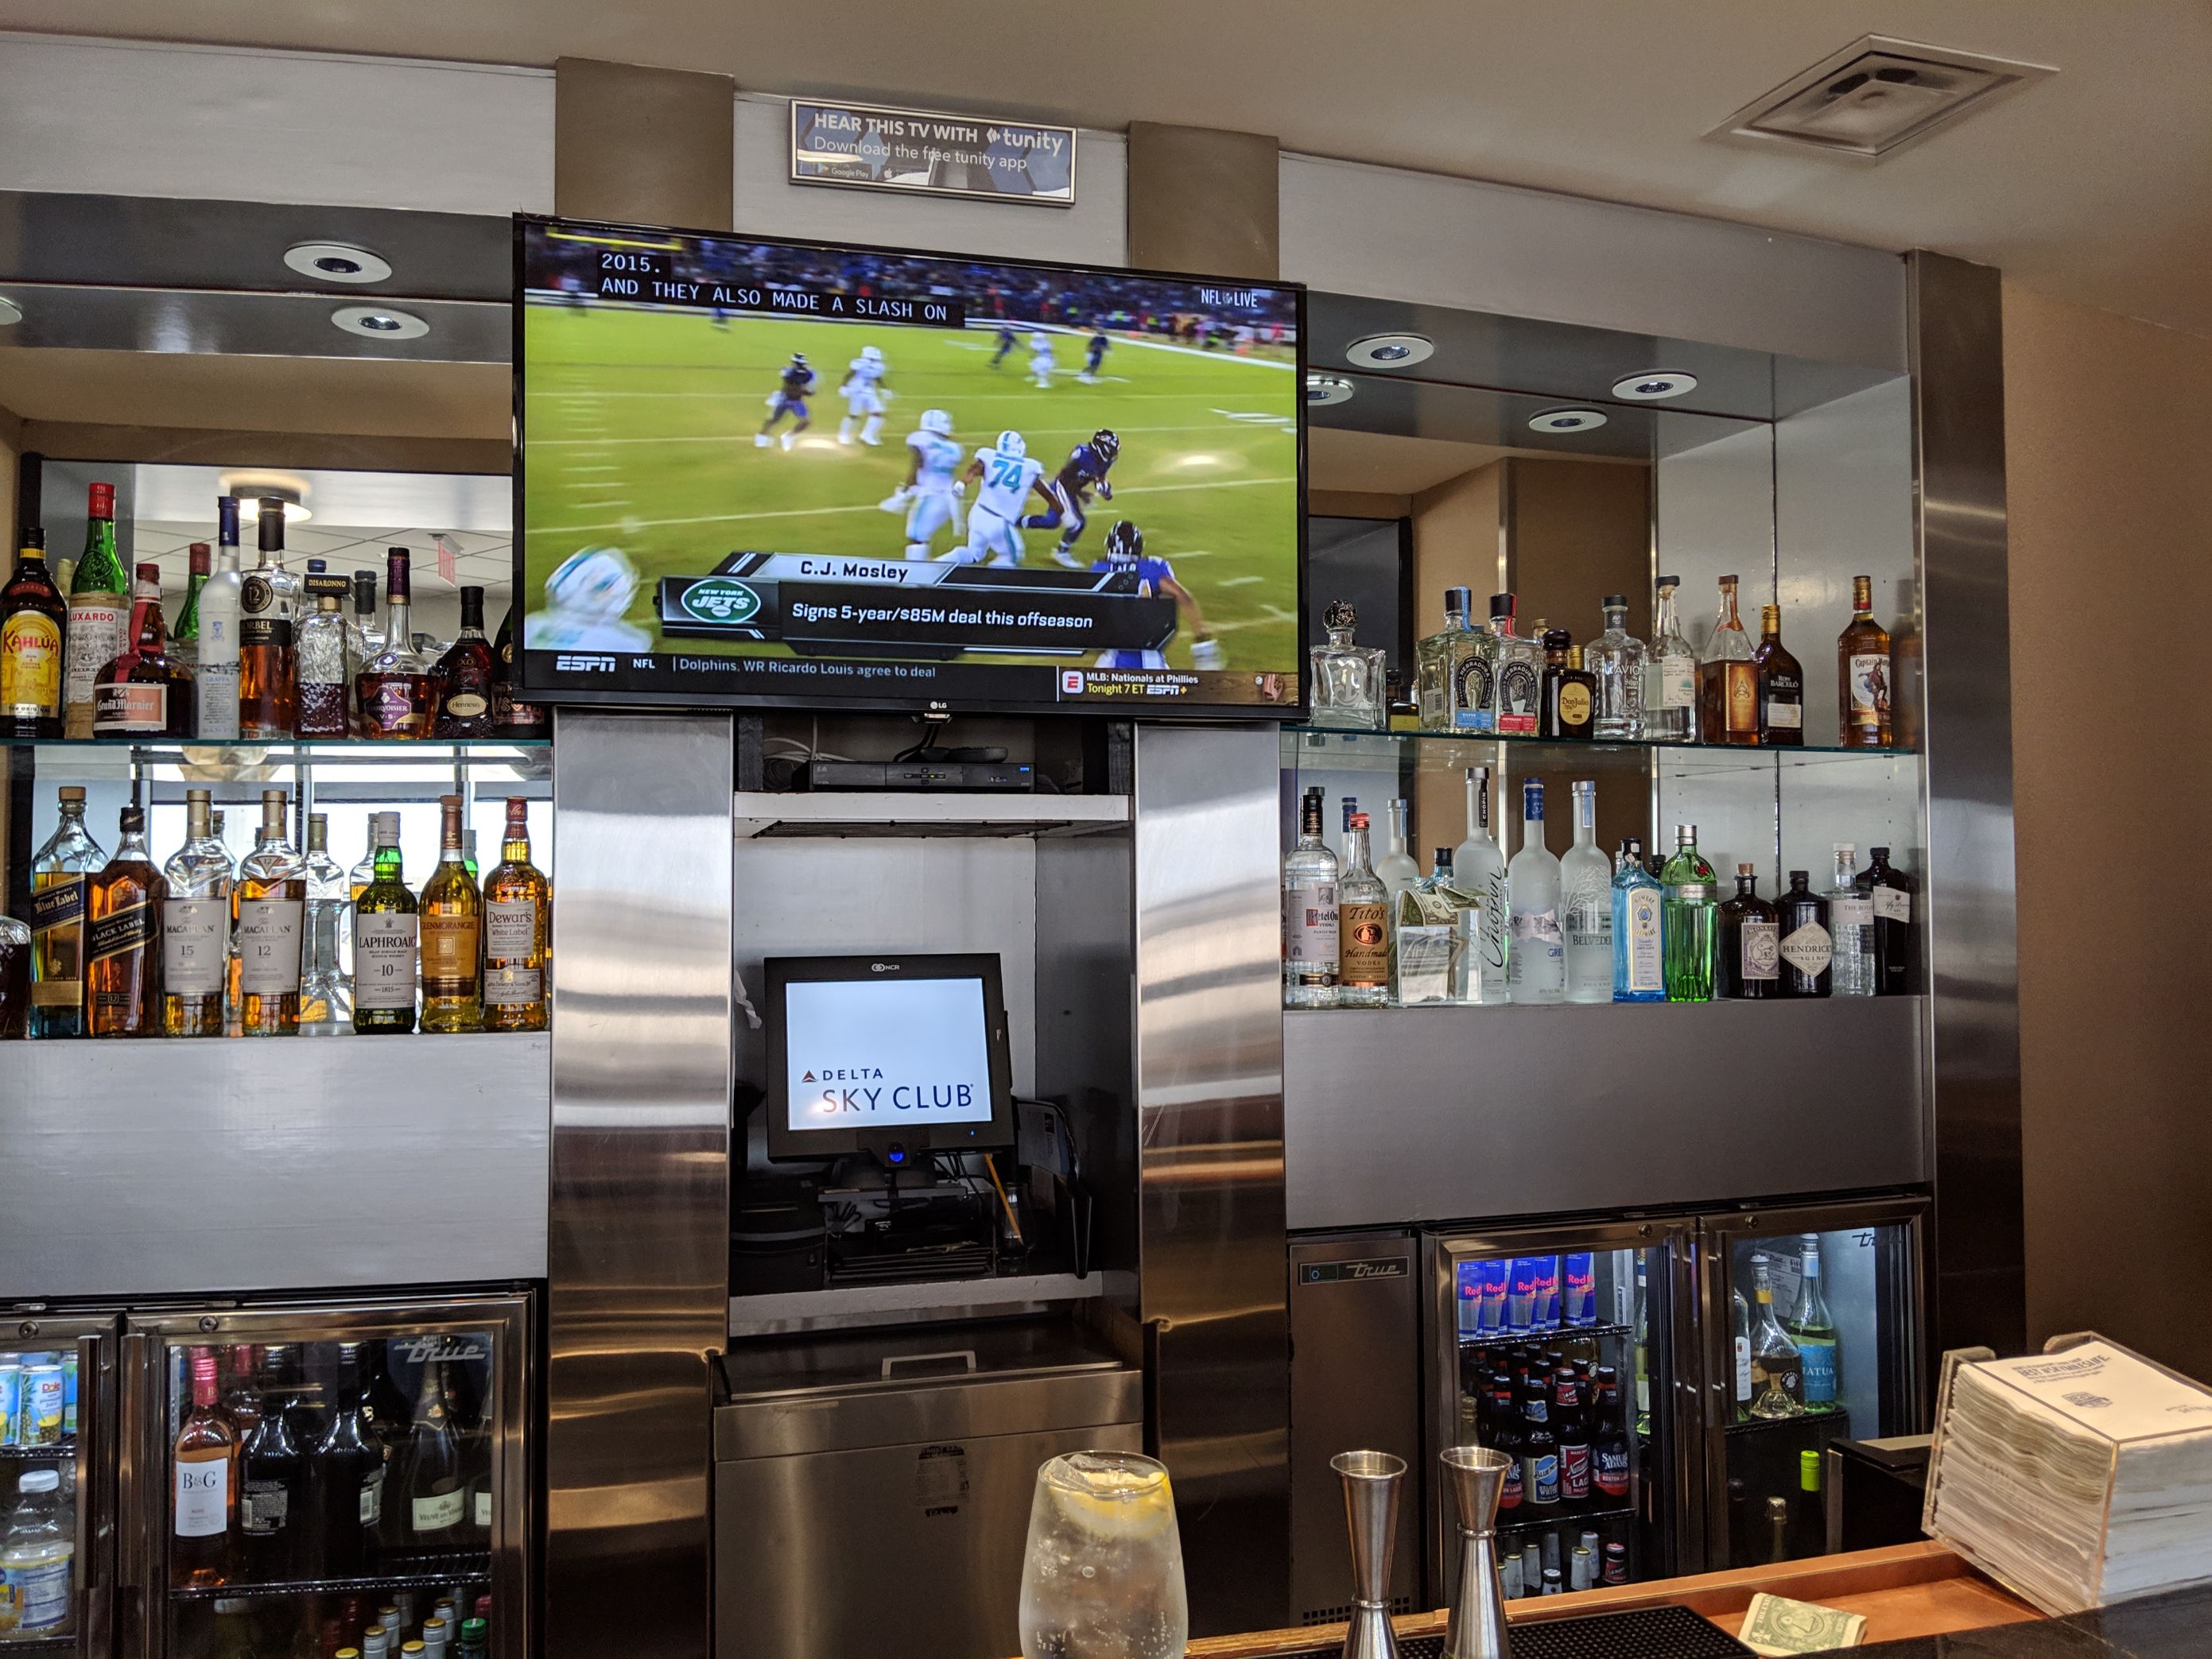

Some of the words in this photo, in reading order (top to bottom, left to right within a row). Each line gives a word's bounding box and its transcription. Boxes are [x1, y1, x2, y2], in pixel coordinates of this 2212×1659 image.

[814, 113, 862, 132] HEAR
[866, 118, 905, 136] THIS
[908, 122, 930, 138] TV
[933, 125, 978, 143] WITH
[1003, 130, 1064, 157] tunity
[814, 136, 891, 157] Download
[895, 145, 919, 160] the
[922, 148, 952, 163] free
[954, 151, 995, 170] tunity
[999, 158, 1027, 173] app
[831, 167, 855, 178] Google
[856, 169, 869, 180] Play
[601, 254, 661, 273] 2015.
[601, 277, 639, 296] AND
[654, 281, 700, 301] THEY
[712, 287, 761, 306] ALSO
[772, 291, 821, 311] MADE
[832, 296, 844, 312] A
[856, 300, 913, 318] SLASH
[924, 305, 947, 321] ON
[1201, 289, 1221, 305] NFL
[1234, 291, 1258, 308] LIVE
[988, 460, 1023, 494] 74
[800, 561, 837, 577] C.J.
[843, 564, 909, 583] Mosley
[308, 579, 347, 588] DISARONNO
[248, 587, 261, 601] 12
[692, 595, 751, 610] JETS
[69, 612, 114, 622] LUXARDO
[792, 603, 837, 622] Signs
[841, 606, 945, 624] 5-year/$85M
[948, 609, 982, 625] deal
[985, 610, 1015, 626] this
[1017, 611, 1093, 629] offseason
[241, 621, 273, 630] ORBEL
[2, 627, 60, 657] KAHLÚA
[557, 656, 615, 673] ESPN
[633, 658, 656, 669] NFL
[743, 661, 765, 672] WR
[769, 661, 817, 675] Ricardo
[821, 662, 854, 676] Louis
[856, 665, 891, 678] agree
[894, 665, 907, 676] to
[910, 665, 937, 677] deal
[1460, 661, 1490, 677] HERRADURA
[1855, 657, 1876, 668] Captain
[1086, 673, 1109, 682] MLB:
[1111, 673, 1154, 684] Nationals
[1155, 674, 1165, 683] at
[1166, 675, 1199, 684] Phillies
[1504, 666, 1534, 682] HERRADURA
[1087, 683, 1123, 696] Tonight
[1124, 684, 1130, 694] 7
[1132, 684, 1145, 695] ET
[1770, 680, 1799, 688] BARCELÓ
[97, 699, 116, 711] Grand
[116, 698, 154, 711] Marnier
[1562, 696, 1575, 705] Don
[1574, 697, 1589, 708] Julio
[34, 900, 55, 913] Blue
[53, 892, 79, 908] Label
[489, 911, 532, 924] Dewar's
[1349, 906, 1385, 920] Tito's
[1480, 866, 1504, 968] Chopin
[118, 918, 145, 931] LABEL
[421, 921, 475, 930] GLENMORANGIE
[181, 945, 194, 955] 15
[258, 945, 271, 955] 12
[1345, 948, 1387, 958] Handmad
[1547, 948, 1564, 957] GRE
[382, 963, 394, 977] 10
[822, 1068, 883, 1081] DELTA
[822, 1087, 883, 1113] SKY
[1518, 1281, 1535, 1291] Red
[1535, 1277, 1552, 1287] Red
[1568, 1274, 1586, 1285] Red
[1465, 1285, 1482, 1296] Red
[1486, 1282, 1504, 1293] Red
[42, 1382, 60, 1393] Dole
[1601, 1452, 1628, 1463] SAMUEL
[1605, 1459, 1628, 1470] ADAMS
[184, 1471, 216, 1489] B&G
[1572, 1477, 1589, 1487] LAG
